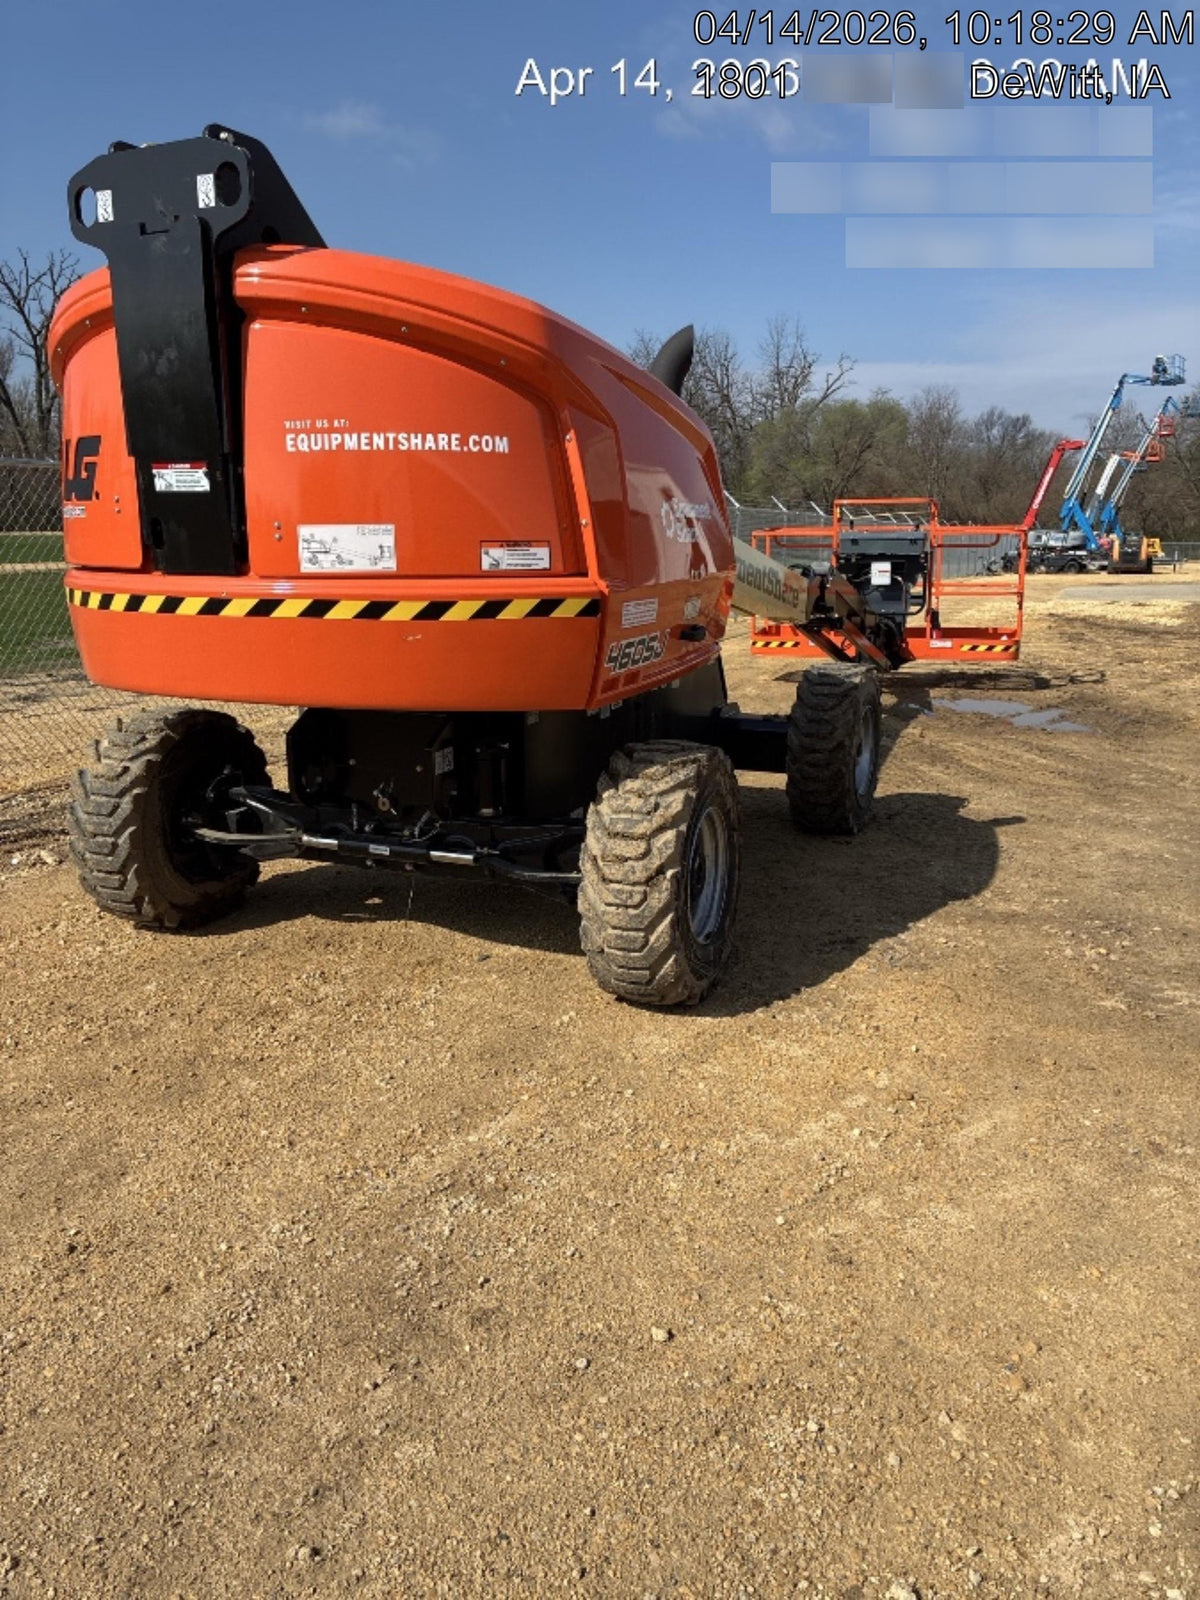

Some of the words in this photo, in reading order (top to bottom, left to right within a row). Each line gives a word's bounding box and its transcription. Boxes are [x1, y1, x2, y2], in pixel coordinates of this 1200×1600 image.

[284, 419, 311, 430] VISIT
[315, 418, 329, 429] US
[333, 418, 349, 429] AT:
[285, 432, 510, 454] EQUIPMENTSHARE.COM
